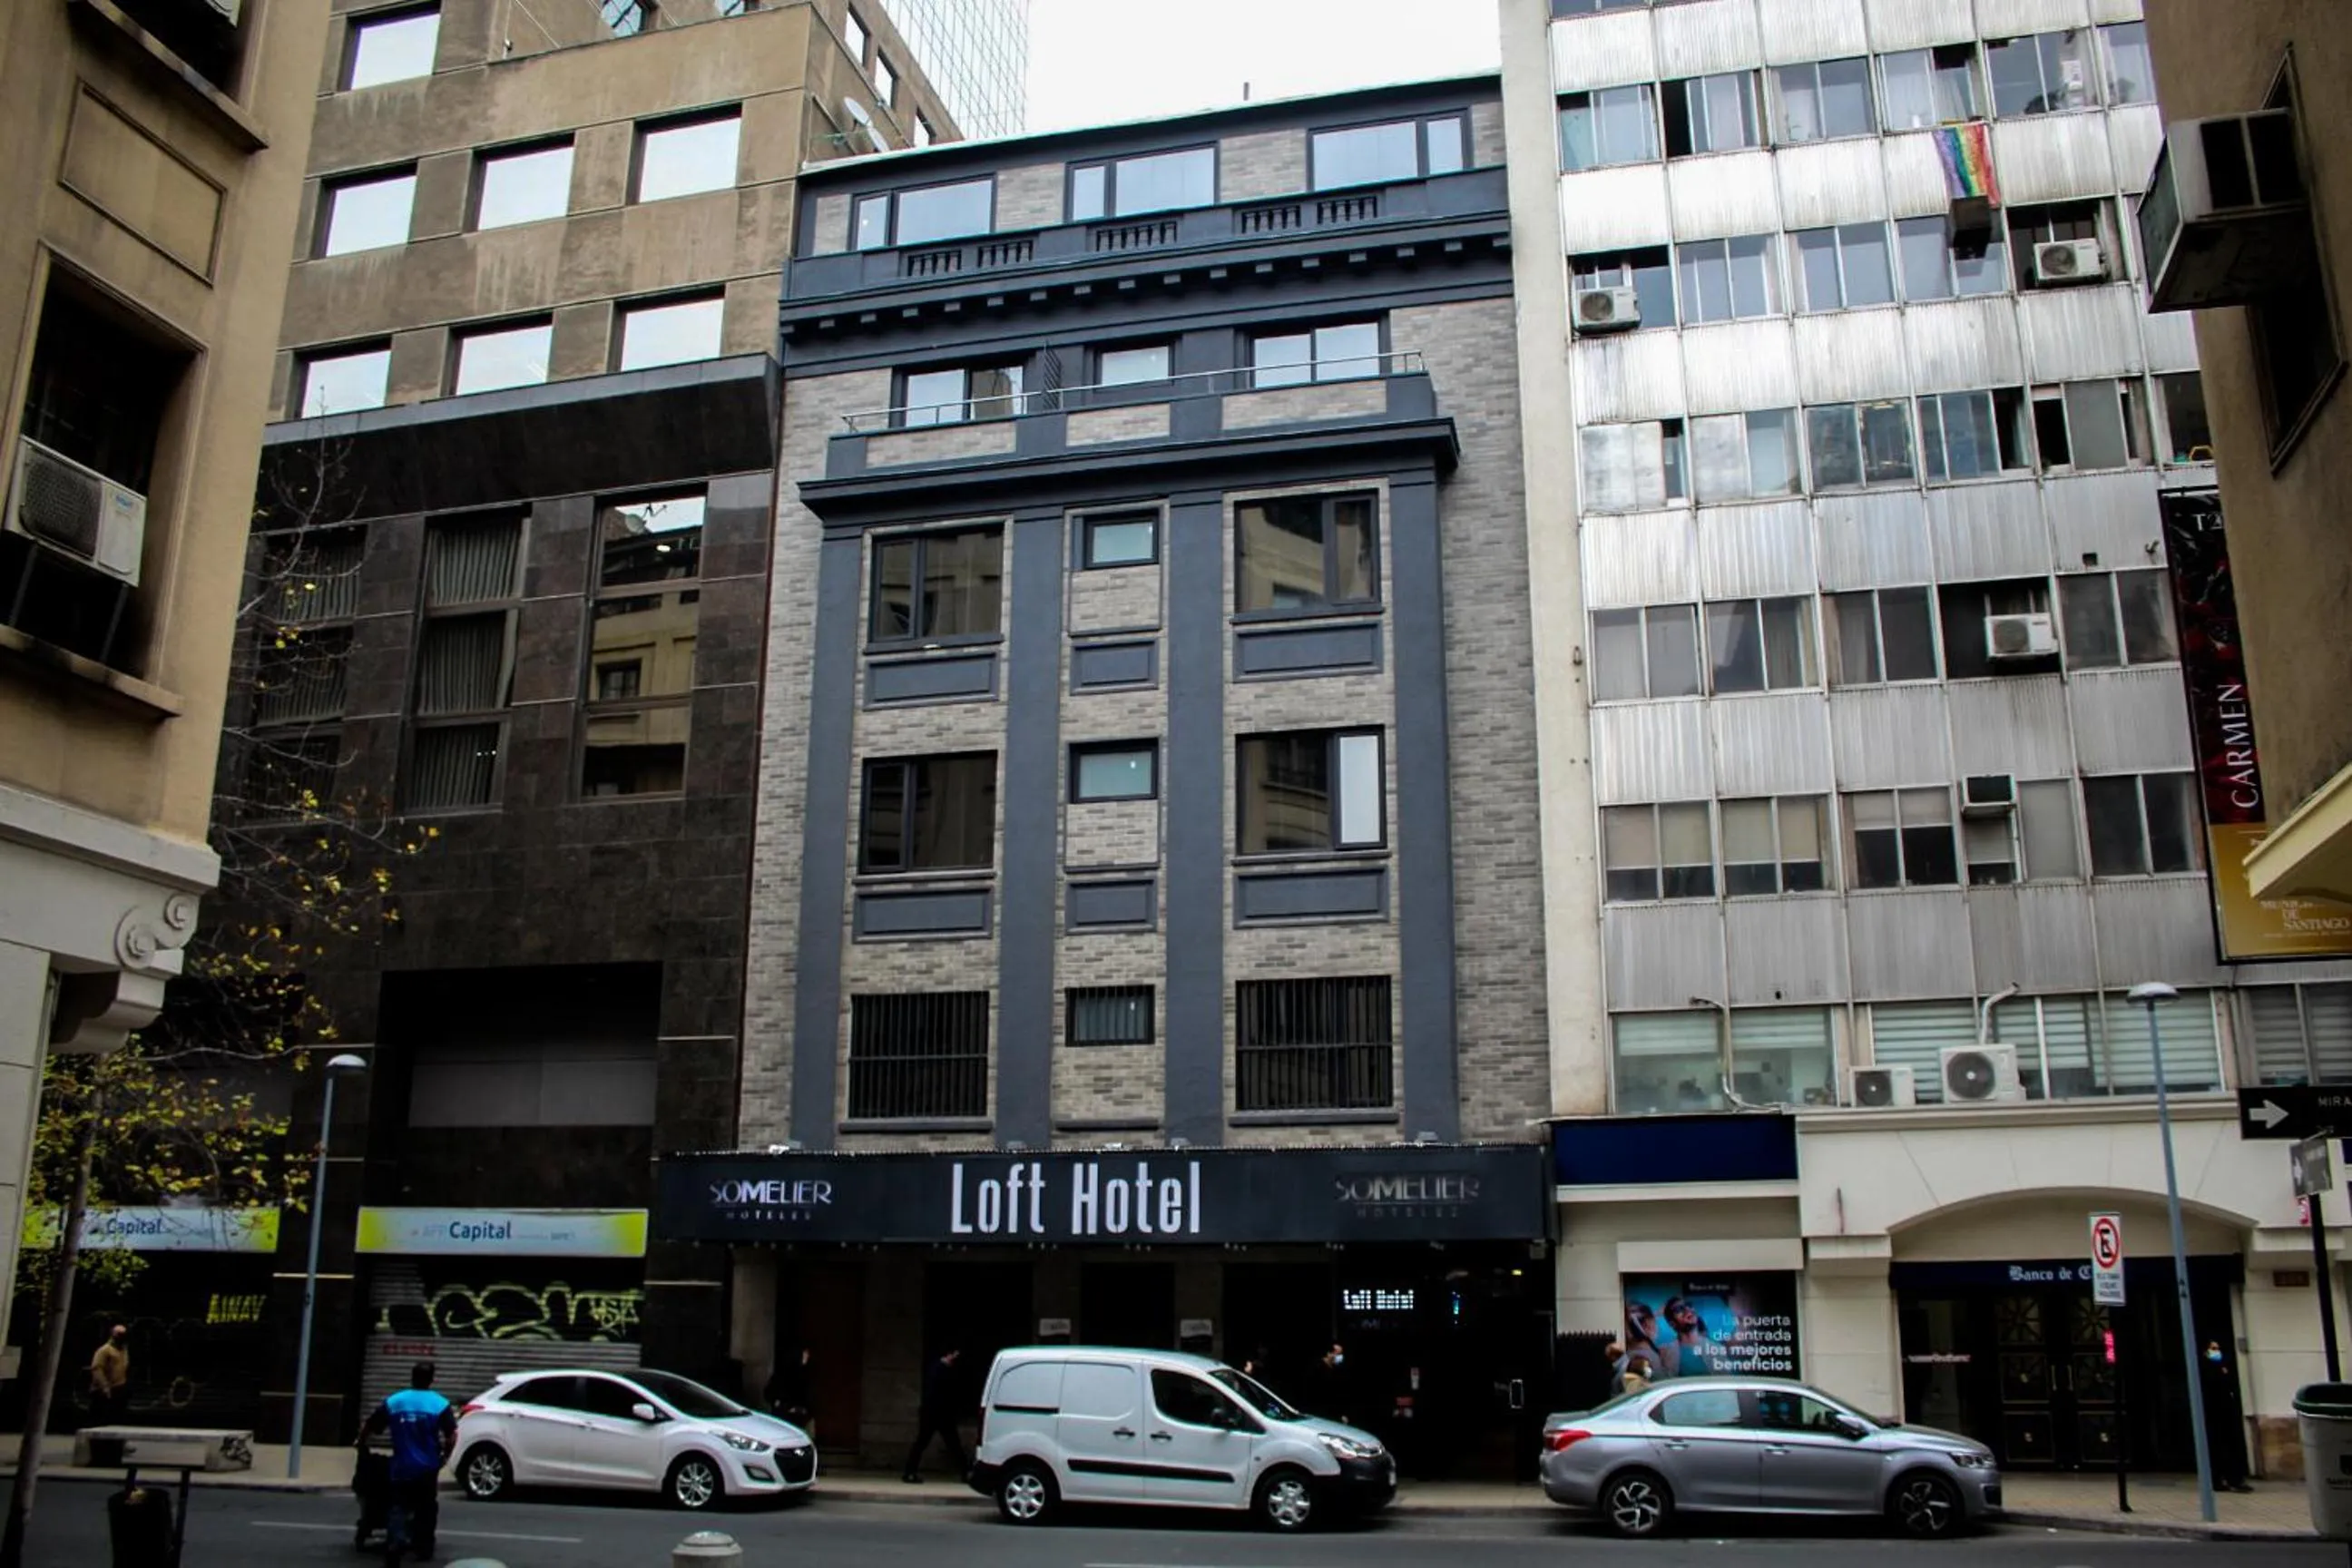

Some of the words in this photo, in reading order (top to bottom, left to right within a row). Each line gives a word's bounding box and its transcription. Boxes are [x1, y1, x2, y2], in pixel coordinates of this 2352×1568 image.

[2216, 684, 2259, 808] CARMEN
[2283, 917, 2350, 930] SANTIAGO
[2318, 1095, 2352, 1108] MIRA
[709, 1179, 832, 1205] SOMELIER
[1335, 1176, 1480, 1201] SOMELIER
[951, 1162, 1045, 1234] Loft
[1072, 1161, 1200, 1234] Hotel
[106, 1218, 162, 1236] Capital
[449, 1220, 512, 1241] Capital
[2008, 1265, 2054, 1281] Banco
[2058, 1266, 2073, 1280] de
[1743, 1315, 1791, 1328] puerta
[1713, 1329, 1731, 1341] de
[1735, 1330, 1792, 1341] entrada
[1693, 1345, 1702, 1356] a
[1706, 1343, 1727, 1356] los
[1730, 1343, 1792, 1360] mejores
[1713, 1357, 1793, 1371] beneficios
